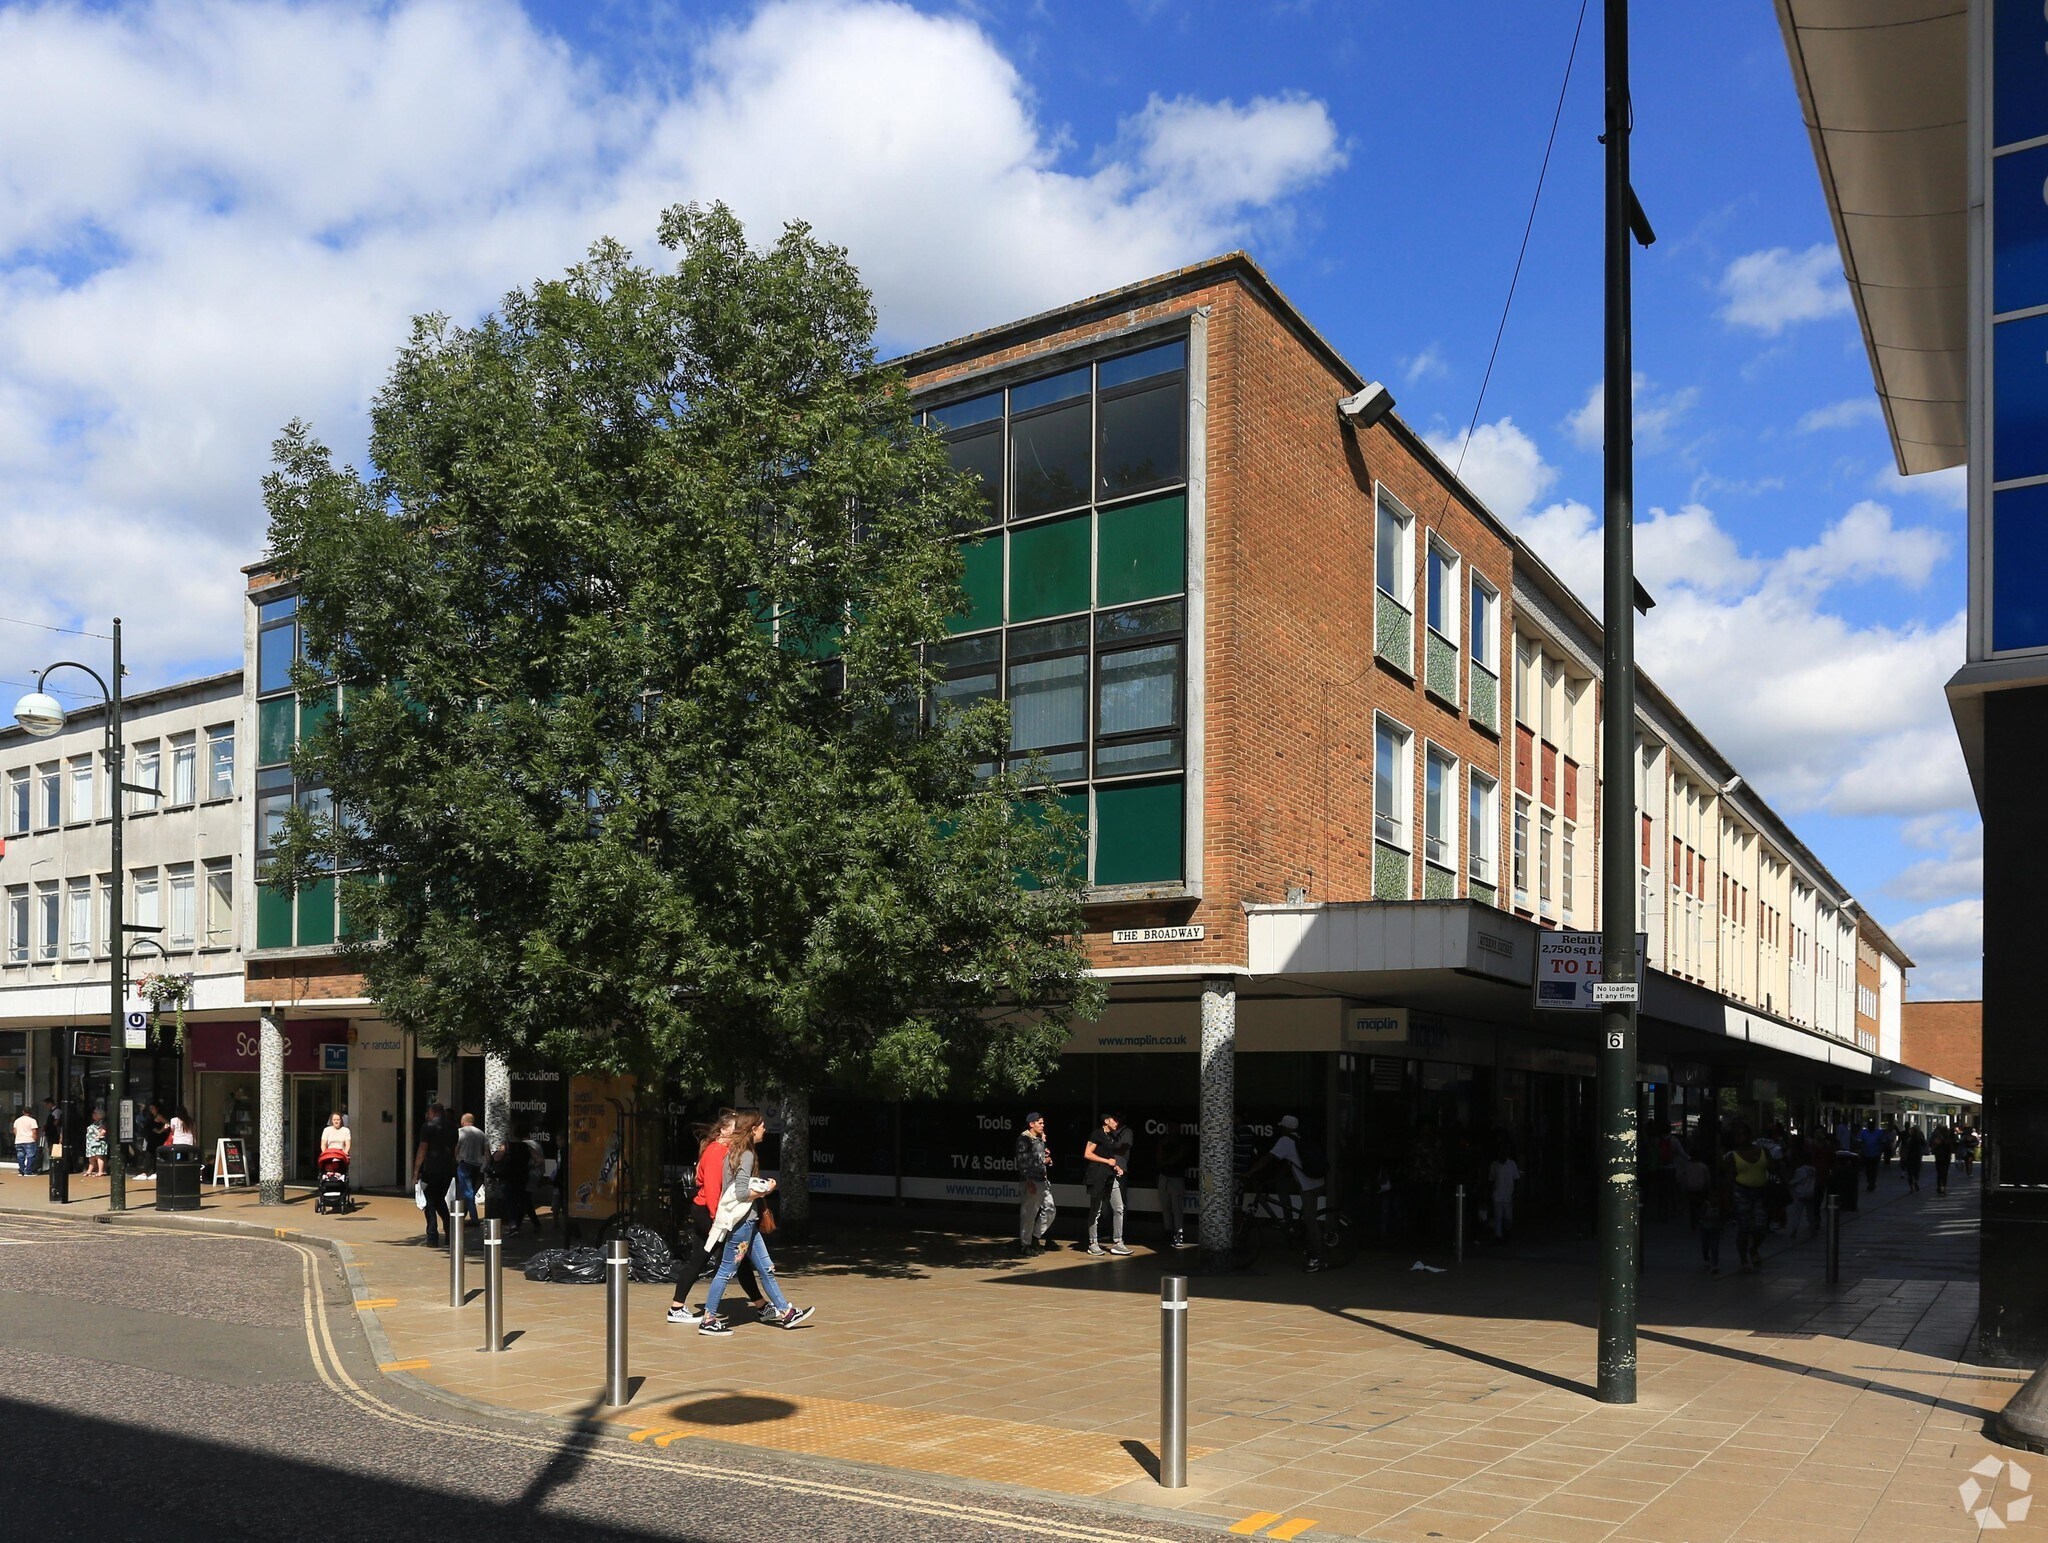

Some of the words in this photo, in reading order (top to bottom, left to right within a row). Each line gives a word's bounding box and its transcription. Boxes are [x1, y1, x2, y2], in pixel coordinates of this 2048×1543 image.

[1117, 931, 1138, 941] THE
[1144, 927, 1200, 940] BROADWAY
[1561, 935, 1595, 945] Retail
[1541, 944, 1572, 955] 2,750
[1573, 947, 1587, 956] sq
[1588, 946, 1596, 955] ft
[1551, 959, 1579, 974] TO
[1609, 985, 1635, 993] loading
[1357, 1017, 1398, 1031] maplin
[237, 1032, 292, 1056] Sce
[372, 1039, 401, 1050] randstad
[1098, 1035, 1187, 1047] www.maplin.co.uk
[1610, 1033, 1620, 1047] 6
[510, 1099, 547, 1113] mputing
[809, 1114, 831, 1126] wer
[976, 1114, 1012, 1130] Tools
[812, 1149, 835, 1163] Nav
[950, 1154, 969, 1169] TV
[971, 1155, 981, 1170] &
[983, 1155, 1018, 1171] Satel
[809, 1174, 831, 1190] plin
[946, 1184, 1020, 1198] www.maplin.
